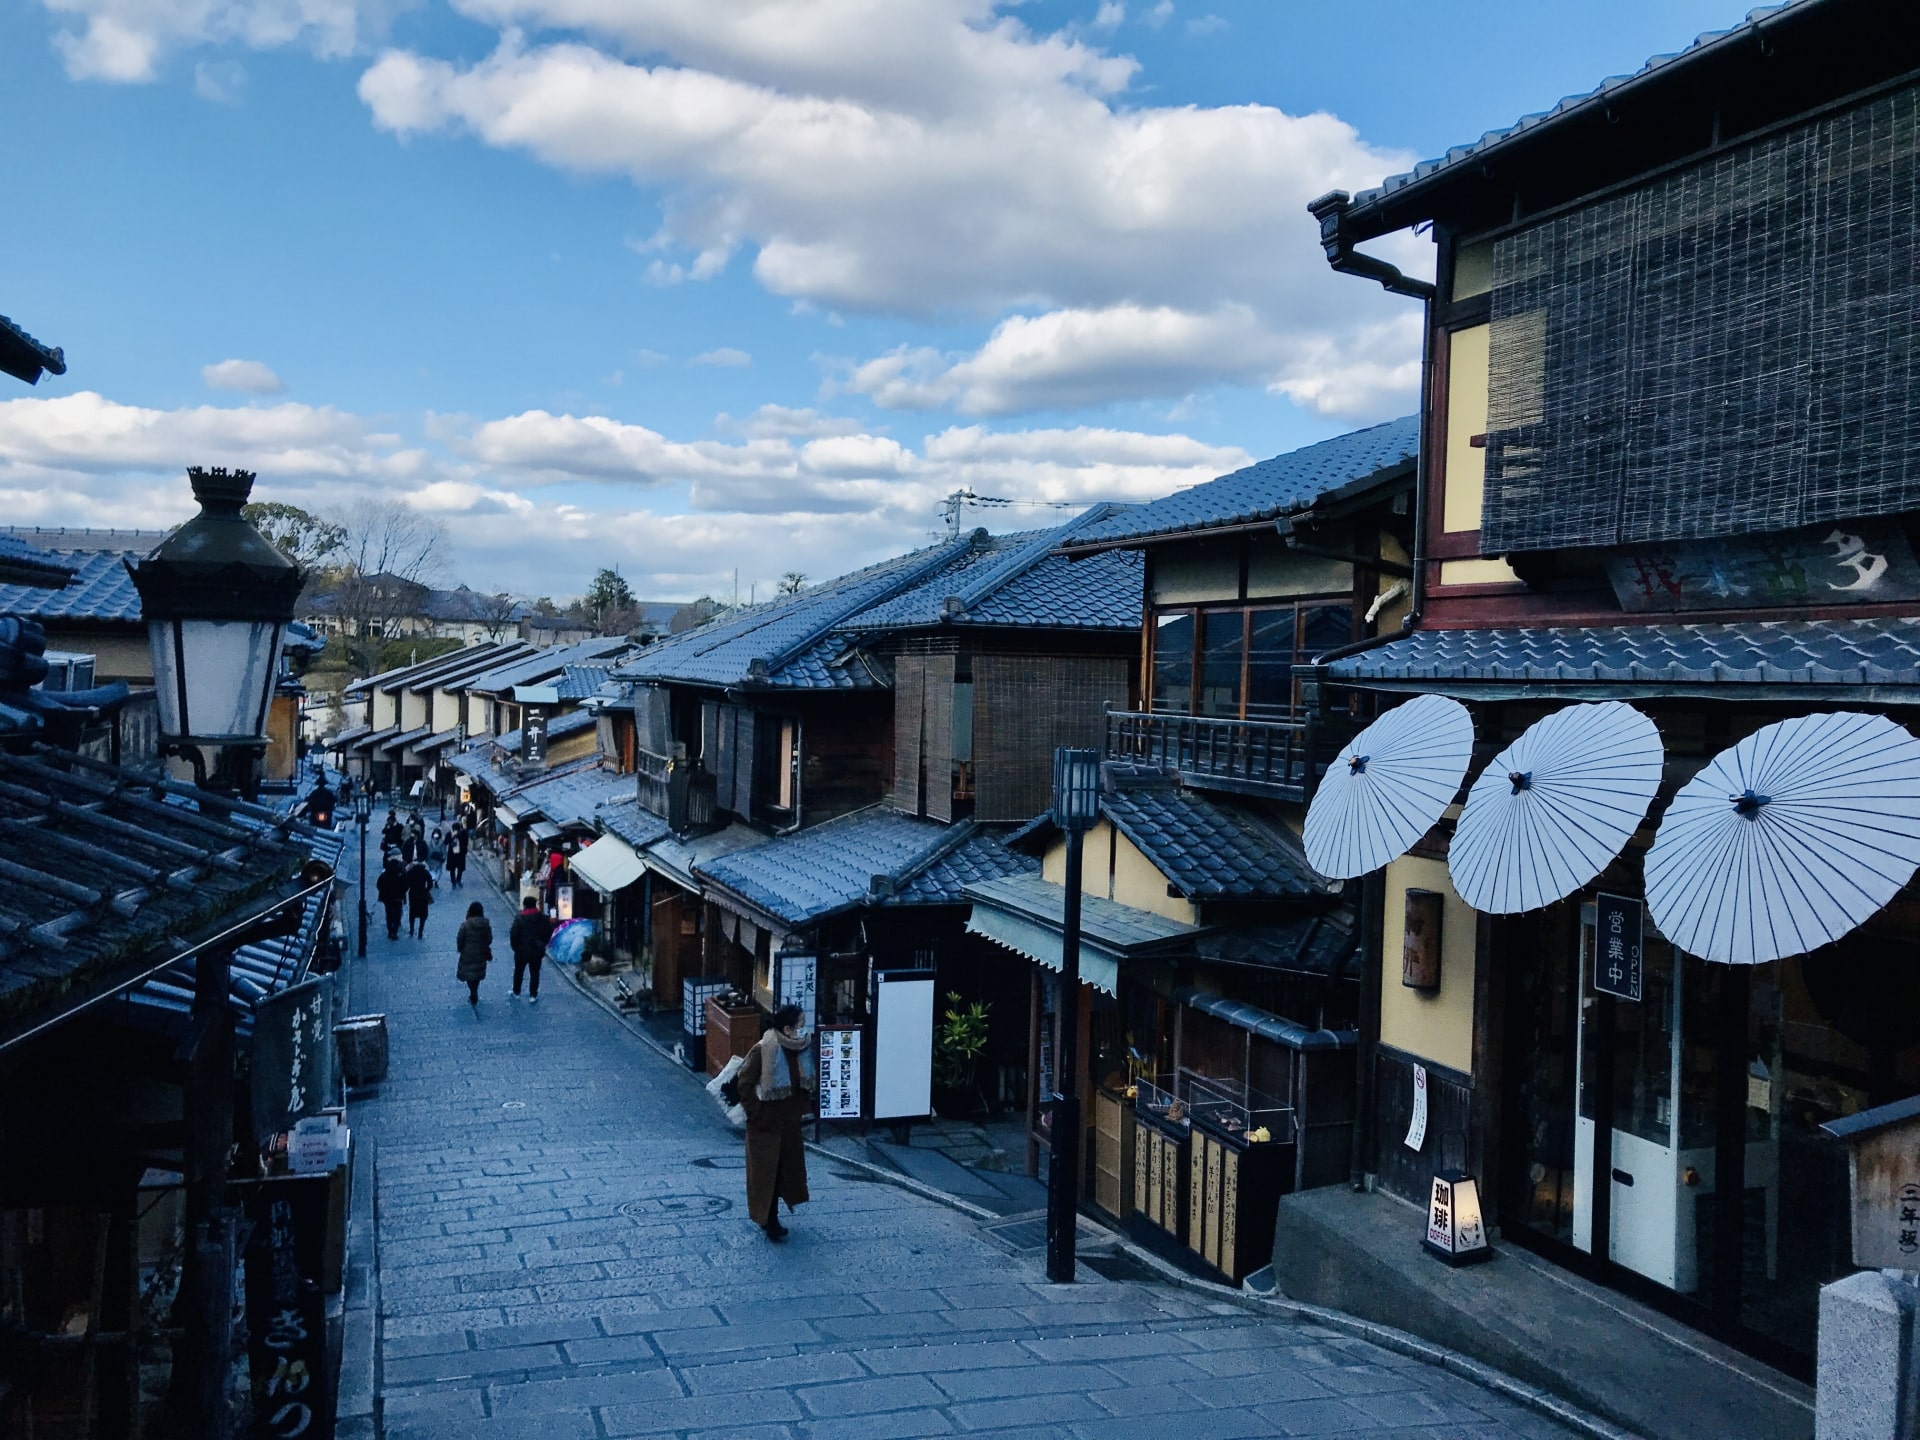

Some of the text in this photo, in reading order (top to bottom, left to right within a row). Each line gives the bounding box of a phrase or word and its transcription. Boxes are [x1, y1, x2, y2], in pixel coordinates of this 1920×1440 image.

[1608, 910, 1625, 986] 営業中
[1629, 944, 1640, 998] OPEN
[1434, 1183, 1449, 1230] 珈琲
[1429, 1228, 1451, 1246] COFFEE
